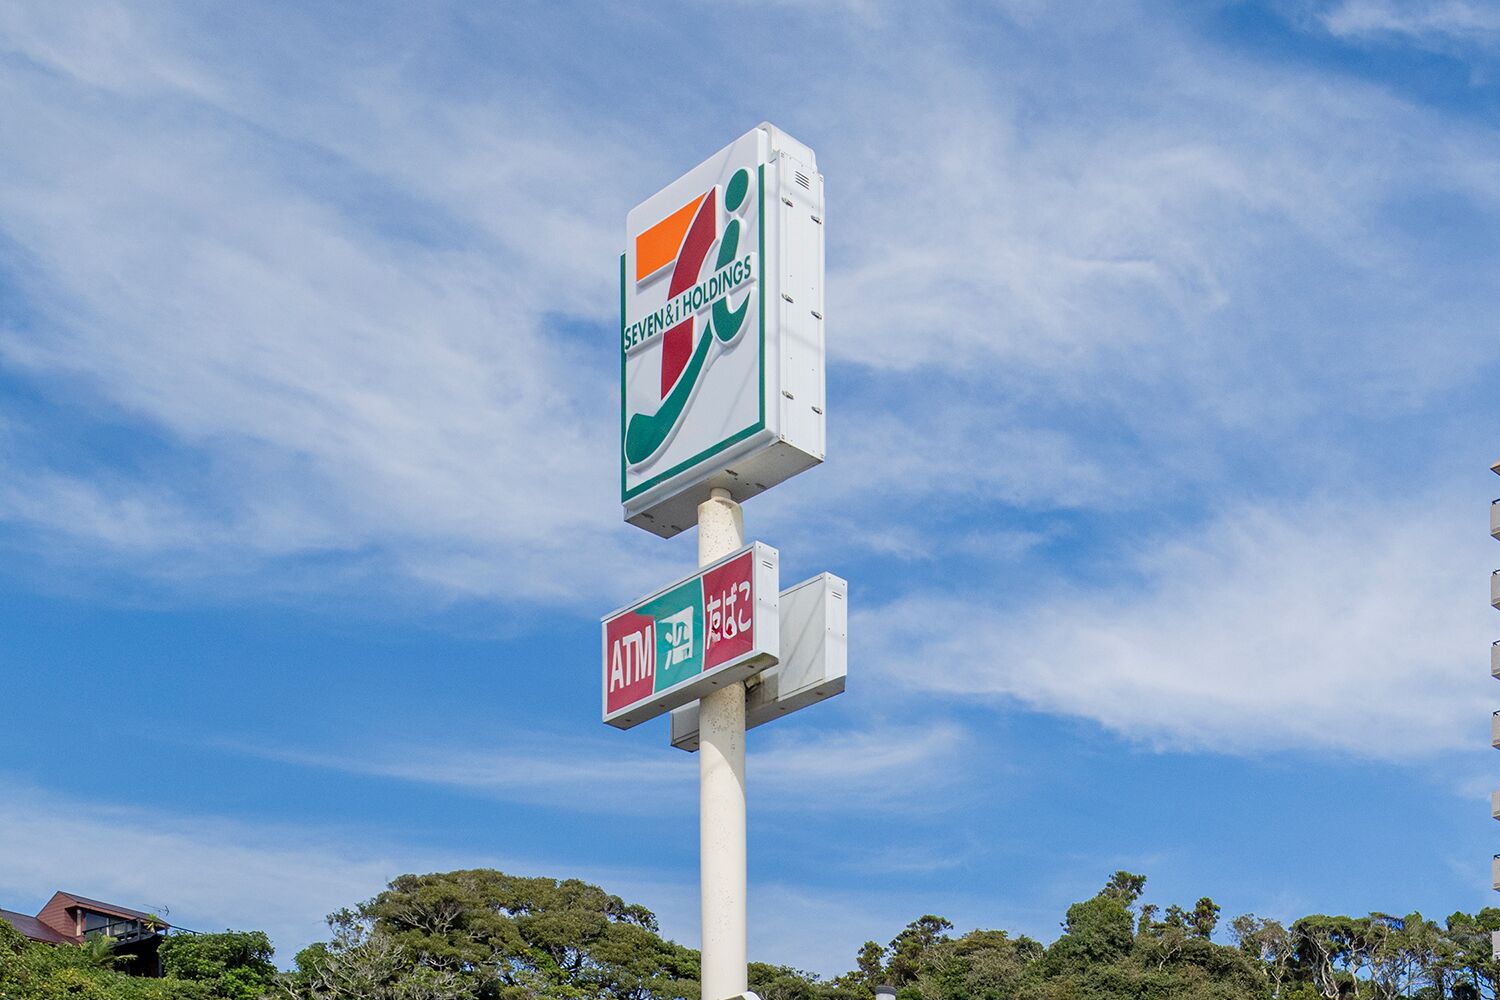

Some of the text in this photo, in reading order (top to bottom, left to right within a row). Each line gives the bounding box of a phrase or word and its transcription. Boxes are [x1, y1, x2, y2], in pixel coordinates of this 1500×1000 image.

[682, 255, 752, 317] HOLDINGS
[706, 580, 752, 650] たばこ
[610, 624, 652, 693] ATM
